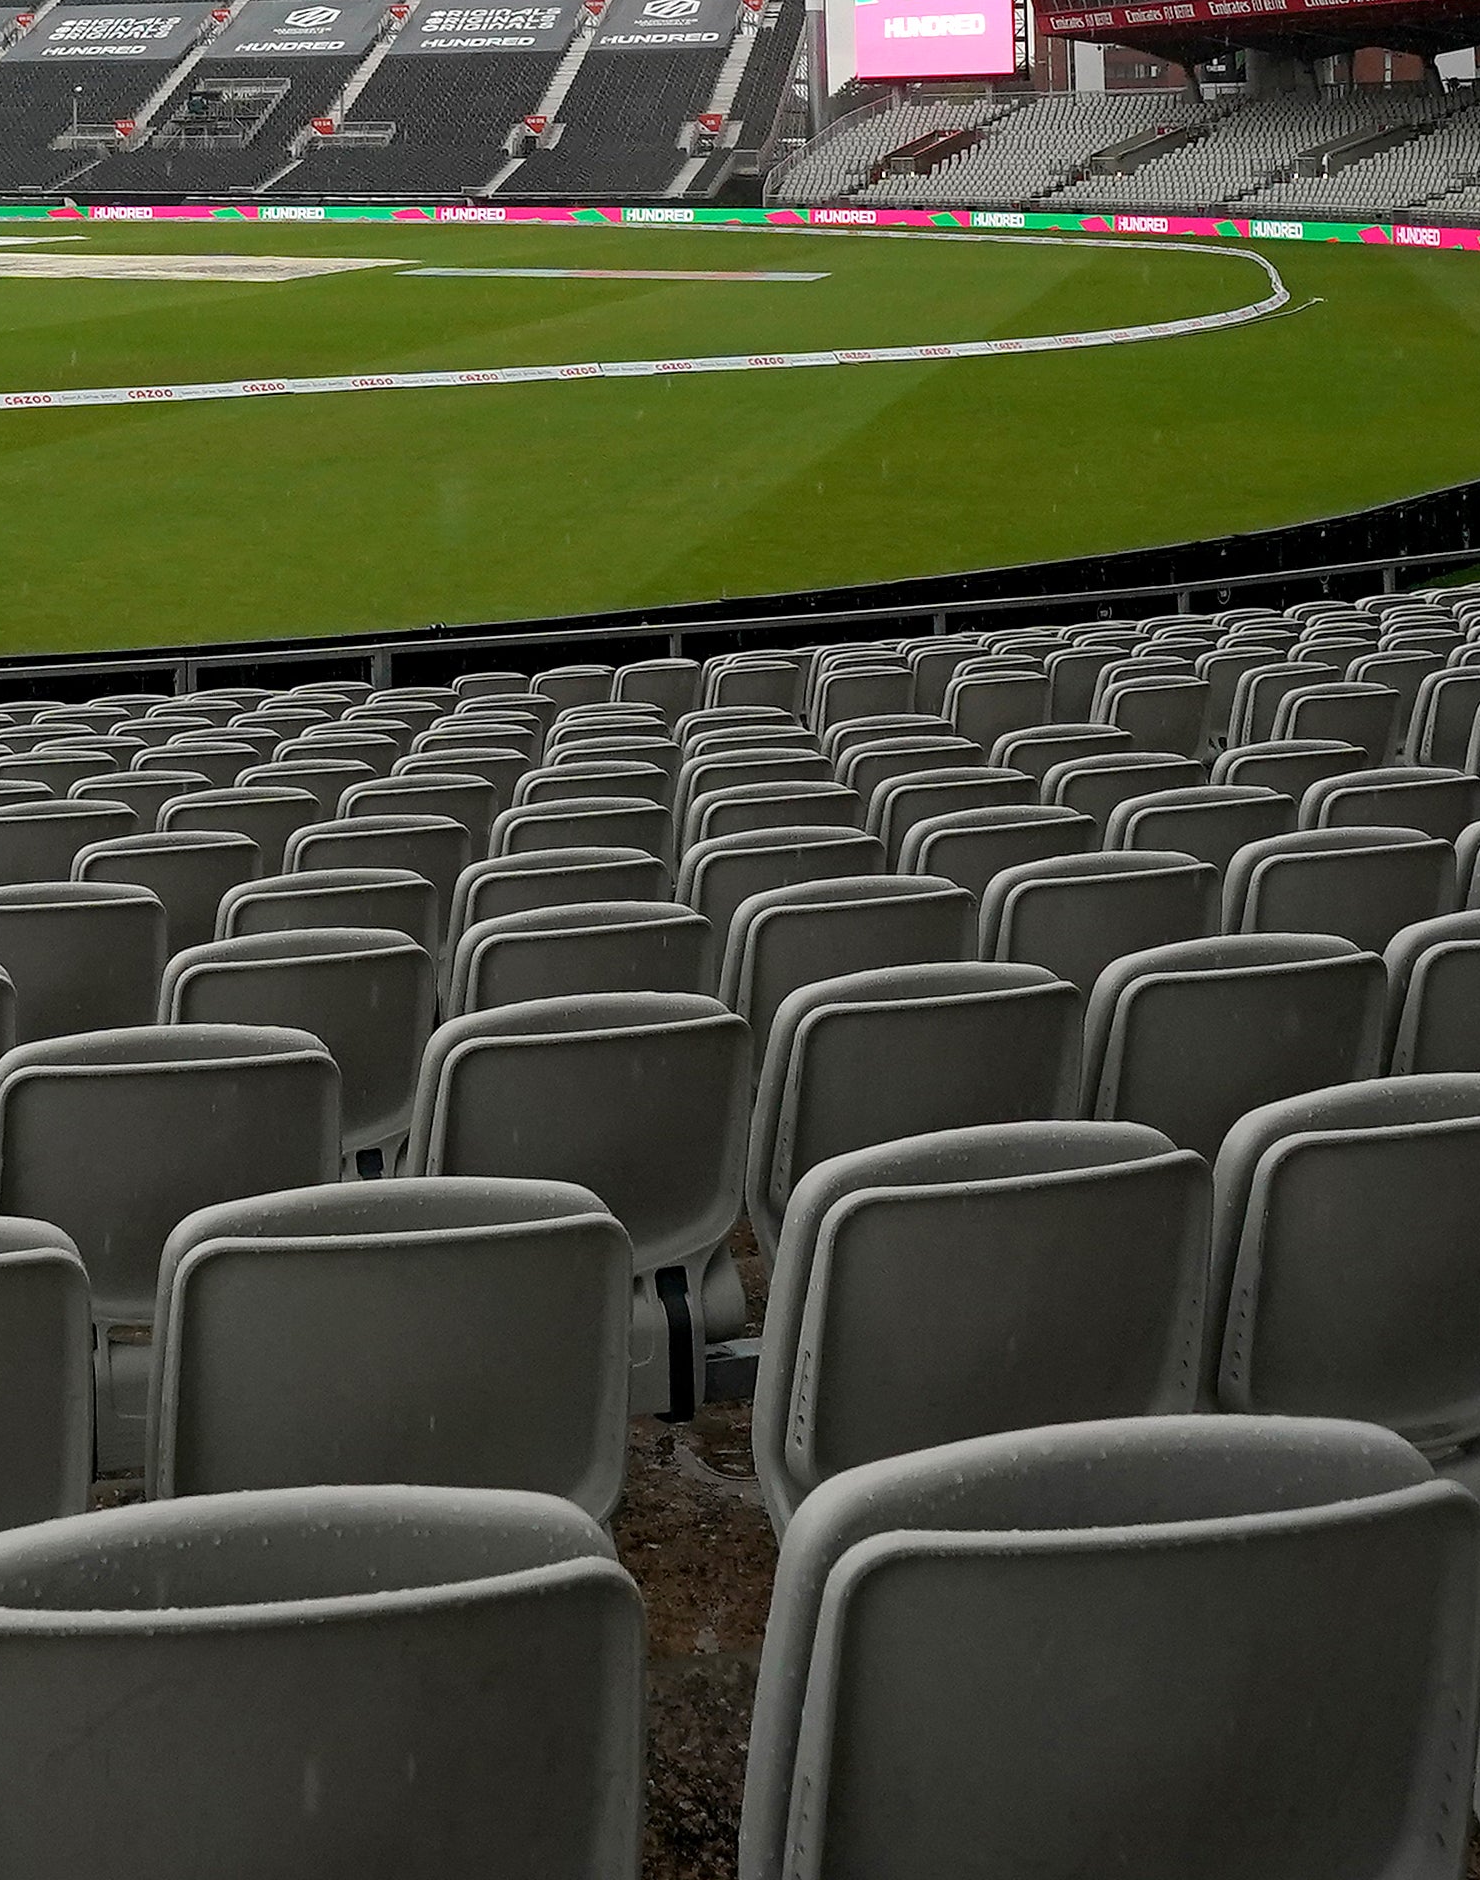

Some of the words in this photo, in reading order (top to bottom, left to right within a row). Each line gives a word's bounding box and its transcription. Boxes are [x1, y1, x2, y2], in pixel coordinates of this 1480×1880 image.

[1208, 0, 1252, 16] Emirates
[1125, 8, 1164, 24] Emirates
[421, 21, 554, 33] ORIGINALS
[884, 13, 986, 39] HUNDRED
[48, 30, 170, 41] ORIGINALS
[420, 36, 537, 48] HUNDRED
[599, 32, 720, 45] HUNDRED
[42, 45, 147, 57] HUNDRED
[234, 40, 346, 53] HUNDRED
[92, 206, 153, 219] HUNDRED
[262, 206, 325, 220] HUNDRED
[441, 207, 507, 221] HUNDRED
[626, 208, 694, 222] HUNDRED
[814, 209, 877, 224] HUNDRED
[973, 212, 1025, 229] HUNDRED
[1117, 215, 1169, 233] HUNDRED
[1252, 221, 1304, 239] HUNDRED
[1396, 226, 1441, 246] HUNDRED
[351, 378, 395, 388] CAZOO
[458, 372, 499, 383] CAZOO
[127, 389, 173, 399] CAZOO
[242, 382, 286, 393] CAZOO
[4, 395, 51, 405] CAZOO
